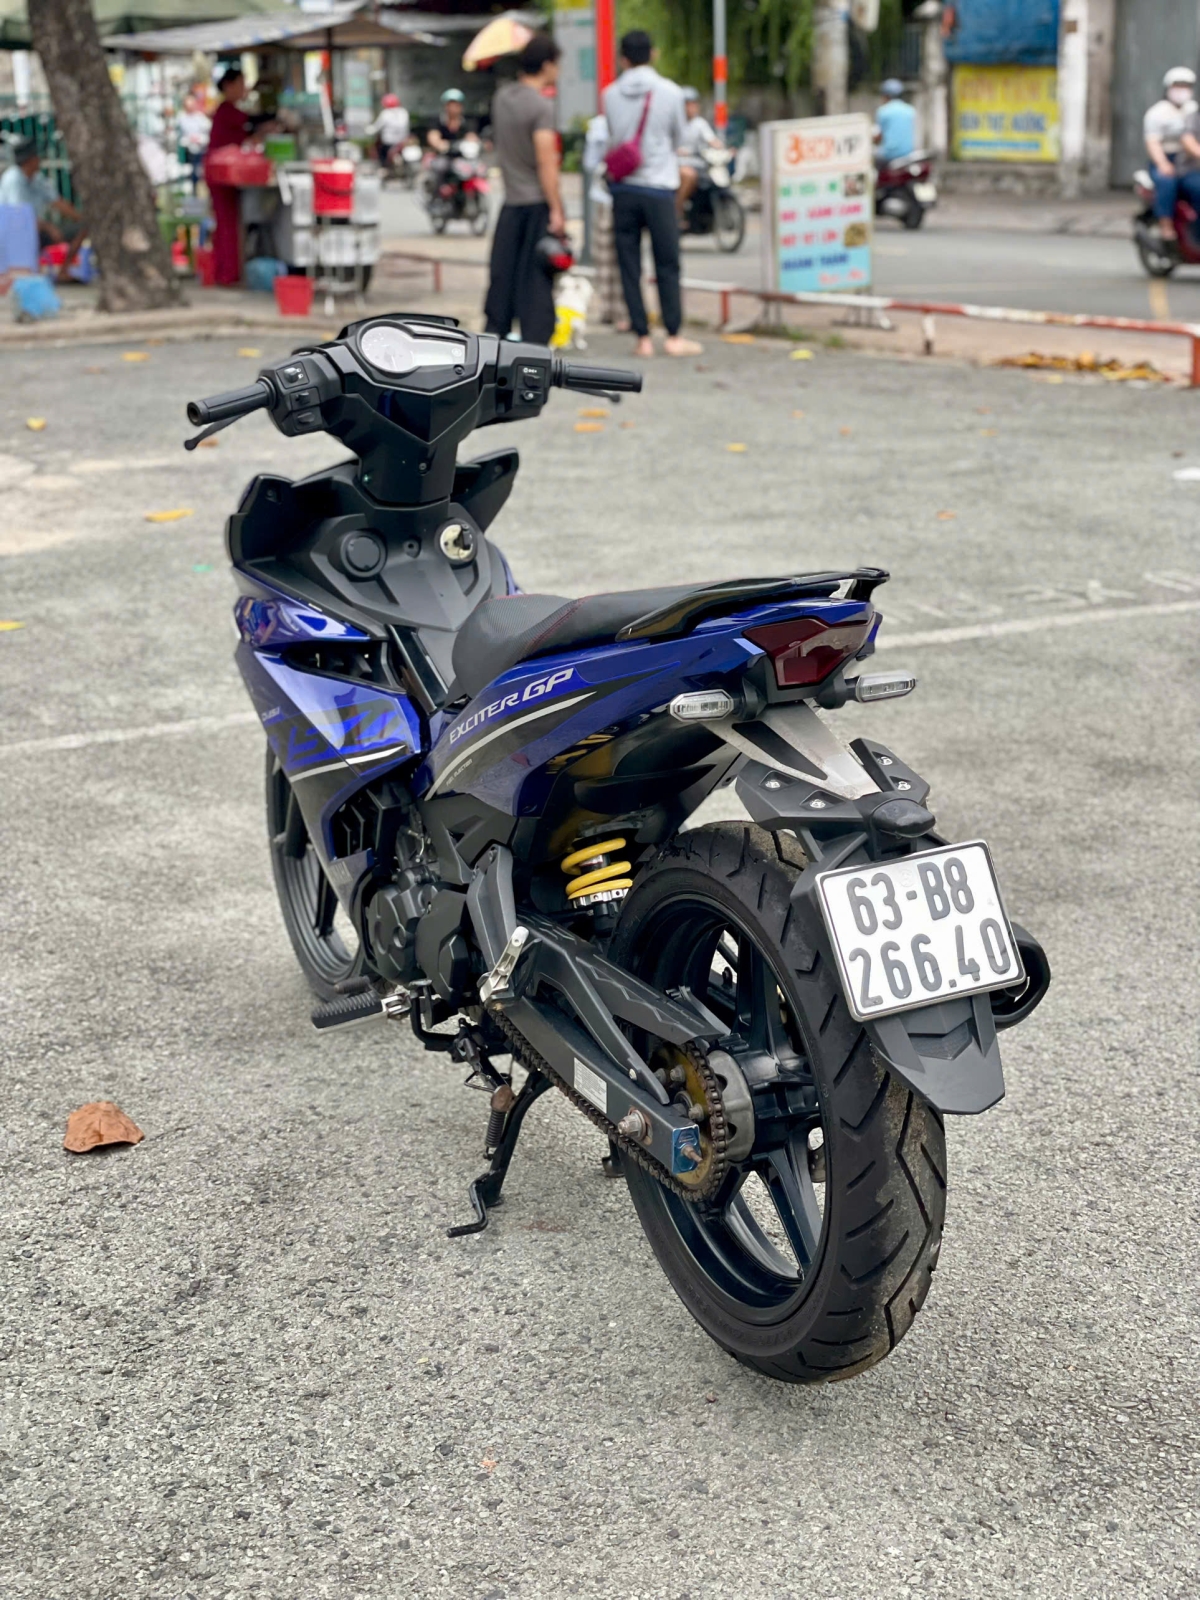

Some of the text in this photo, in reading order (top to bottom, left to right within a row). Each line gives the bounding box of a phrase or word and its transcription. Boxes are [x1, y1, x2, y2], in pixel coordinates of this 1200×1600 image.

[450, 692, 519, 744] EXCITER
[522, 667, 574, 702] GP
[846, 857, 975, 936] 63-B8
[849, 917, 1011, 1008] 266.40
